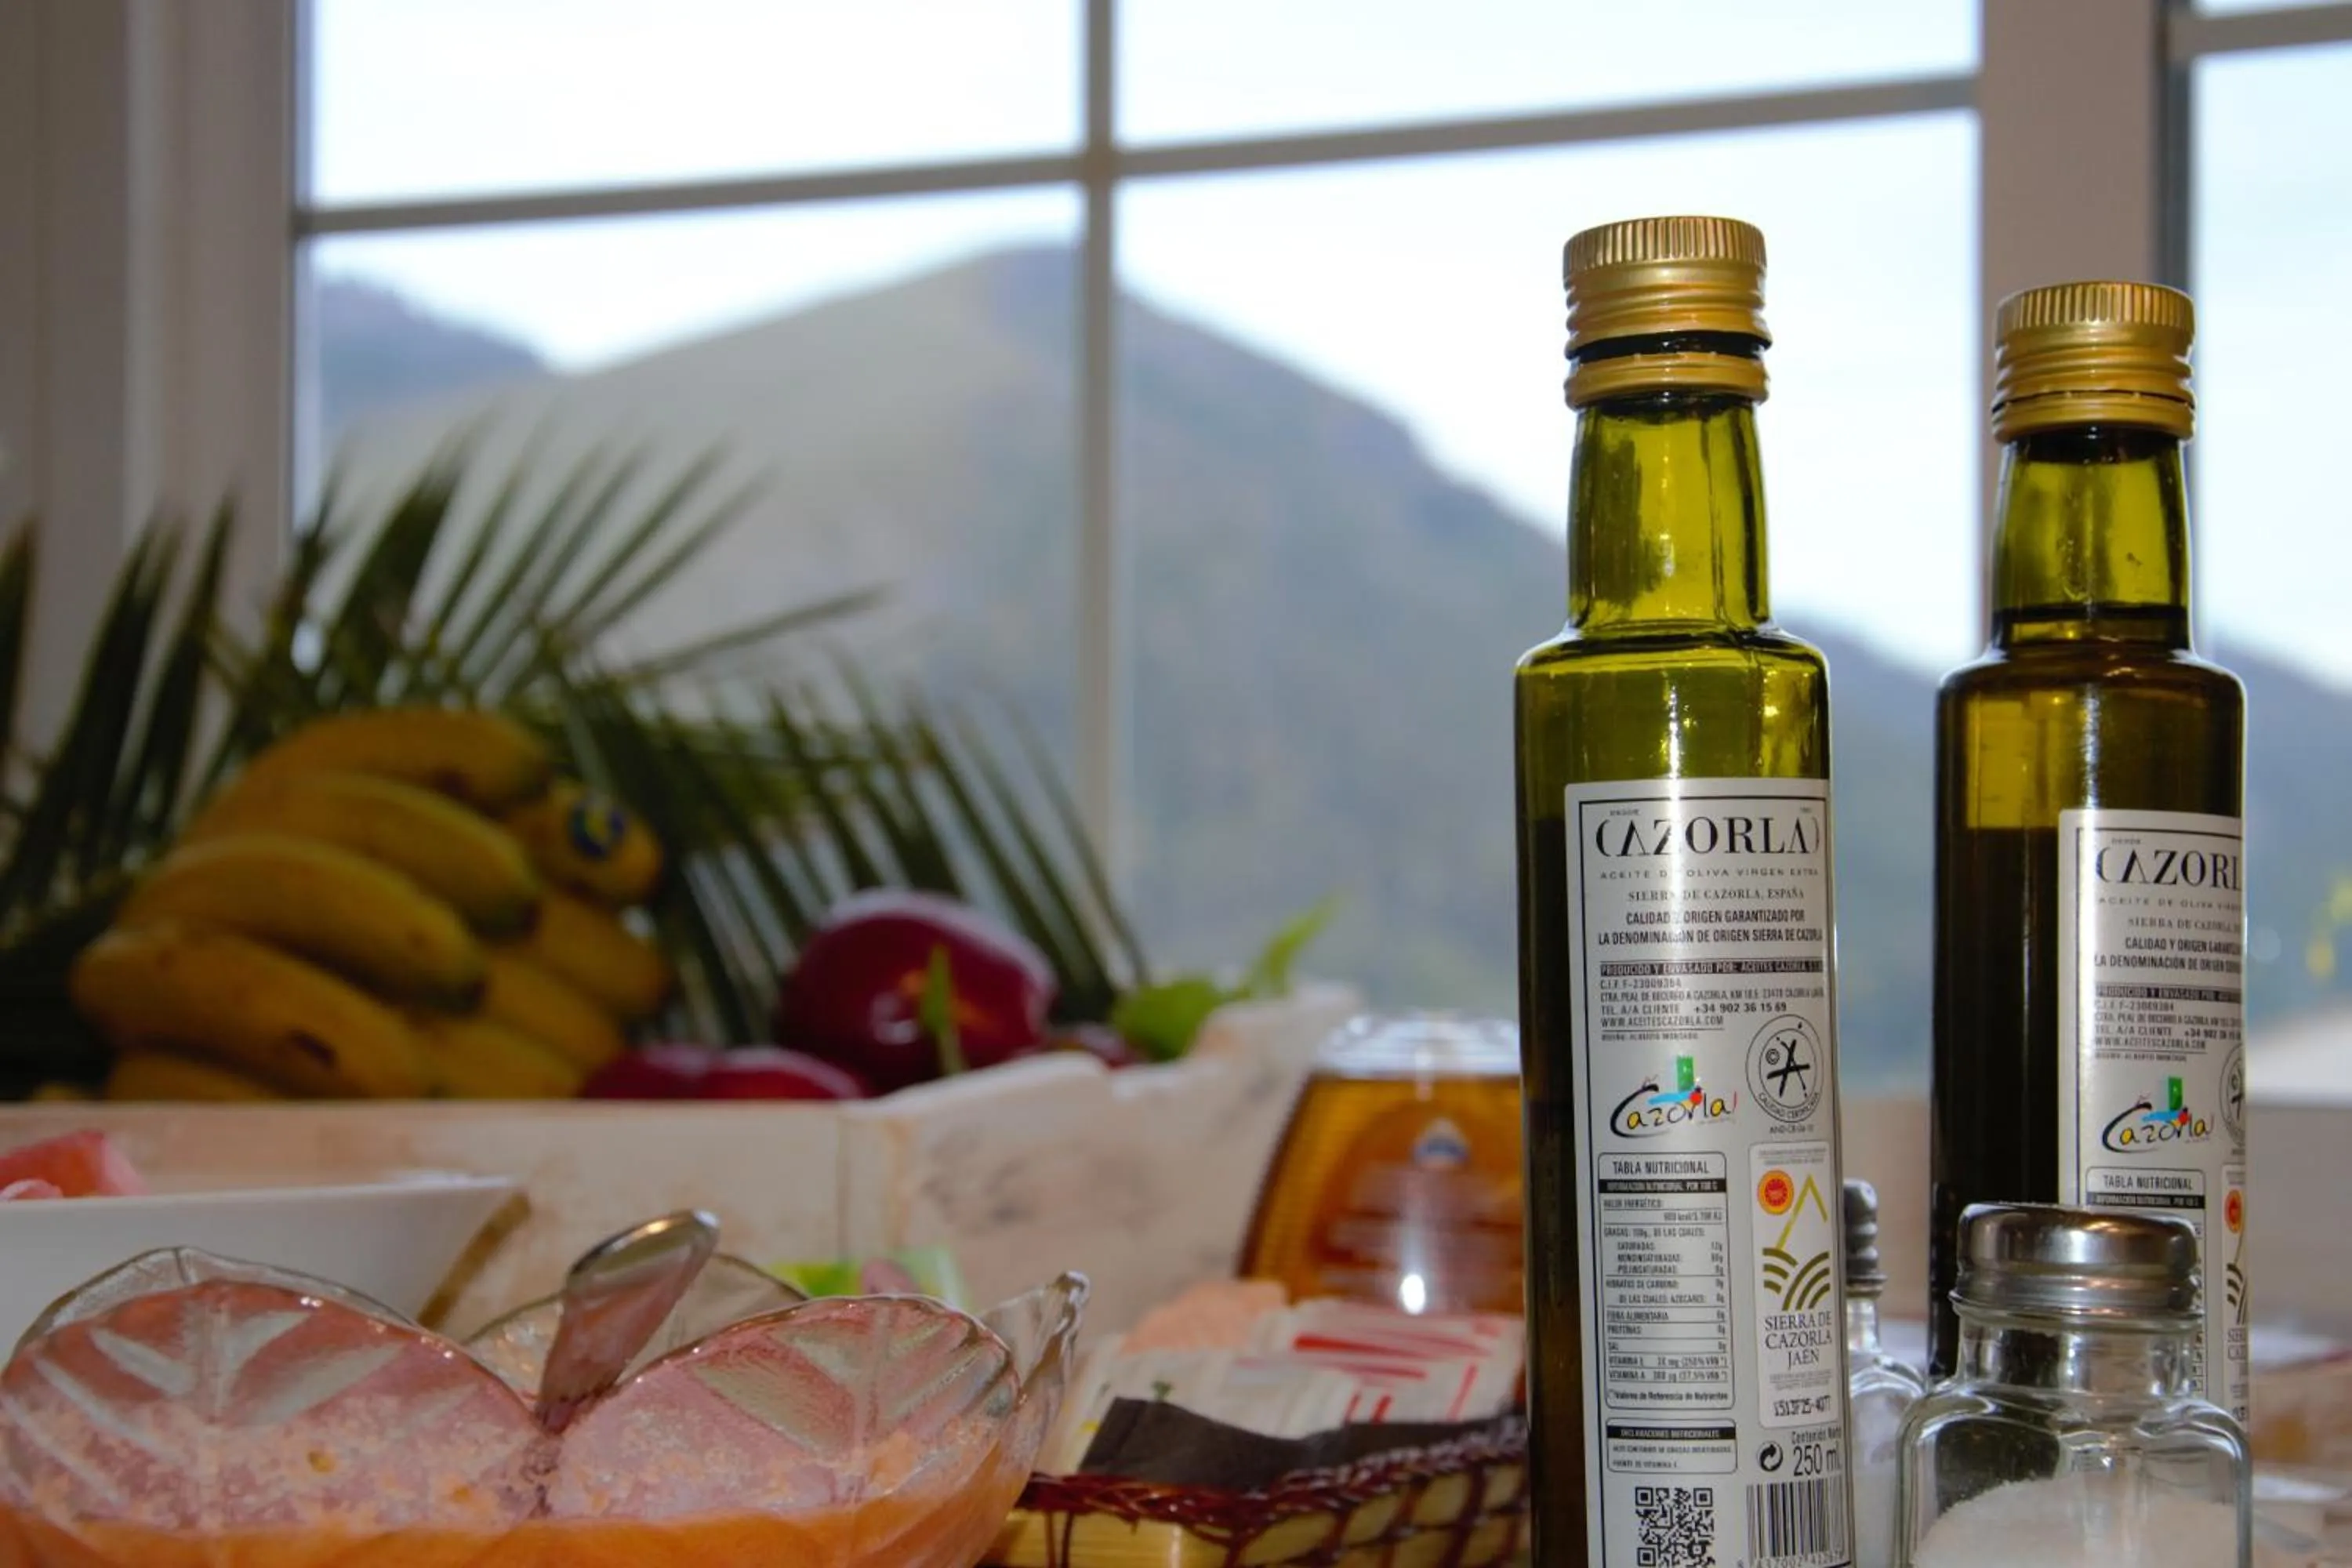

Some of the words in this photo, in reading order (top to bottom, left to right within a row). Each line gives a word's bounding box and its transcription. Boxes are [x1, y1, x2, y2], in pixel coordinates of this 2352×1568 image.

[1600, 869, 1650, 880] ACEITE
[1686, 868, 1730, 878] OLIVA
[1737, 867, 1784, 877] VIRGEN
[1789, 867, 1819, 877] EXTRA
[2096, 846, 2242, 892] CAZORL
[1767, 886, 1805, 899] ESPAÑA
[1625, 910, 1671, 926] CALIDAD
[1682, 909, 1722, 924] ORIGEN
[1724, 909, 1788, 924] GARANTIZADO
[1790, 908, 1806, 922] POR
[2176, 917, 2191, 930] DE
[1598, 932, 1610, 946] LA
[1697, 930, 1711, 942] DE
[1713, 928, 1750, 942] ORIGEN
[1751, 928, 1784, 942] SIERRA
[1784, 927, 1795, 941] DE
[2125, 936, 2167, 950] CALIDAD
[2169, 938, 2176, 950] Y
[2177, 938, 2208, 954] ORIGEN
[2094, 953, 2107, 967] LA
[2187, 956, 2198, 971] DE
[1621, 1004, 1639, 1014] A/A
[1693, 1003, 1716, 1014] +34
[1719, 1002, 1740, 1013] 902
[1744, 1002, 1757, 1013] 36
[1761, 1001, 1773, 1012] 15
[1774, 1001, 1788, 1012] 69
[2116, 1025, 2135, 1036] A/A
[1610, 1083, 1732, 1139] Cazorla
[2102, 1102, 2211, 1153] Cazorla
[1612, 1160, 1642, 1175] TABLA
[1645, 1160, 1711, 1174] NUTRICIONAL
[2103, 1174, 2134, 1189] TABLA
[2136, 1175, 2194, 1191] NUTRICIONAL
[1764, 1312, 1817, 1331] SIERRA
[1817, 1310, 1832, 1327] DE
[1765, 1329, 1833, 1350] CAZORLA
[1793, 1443, 1824, 1477] 250
